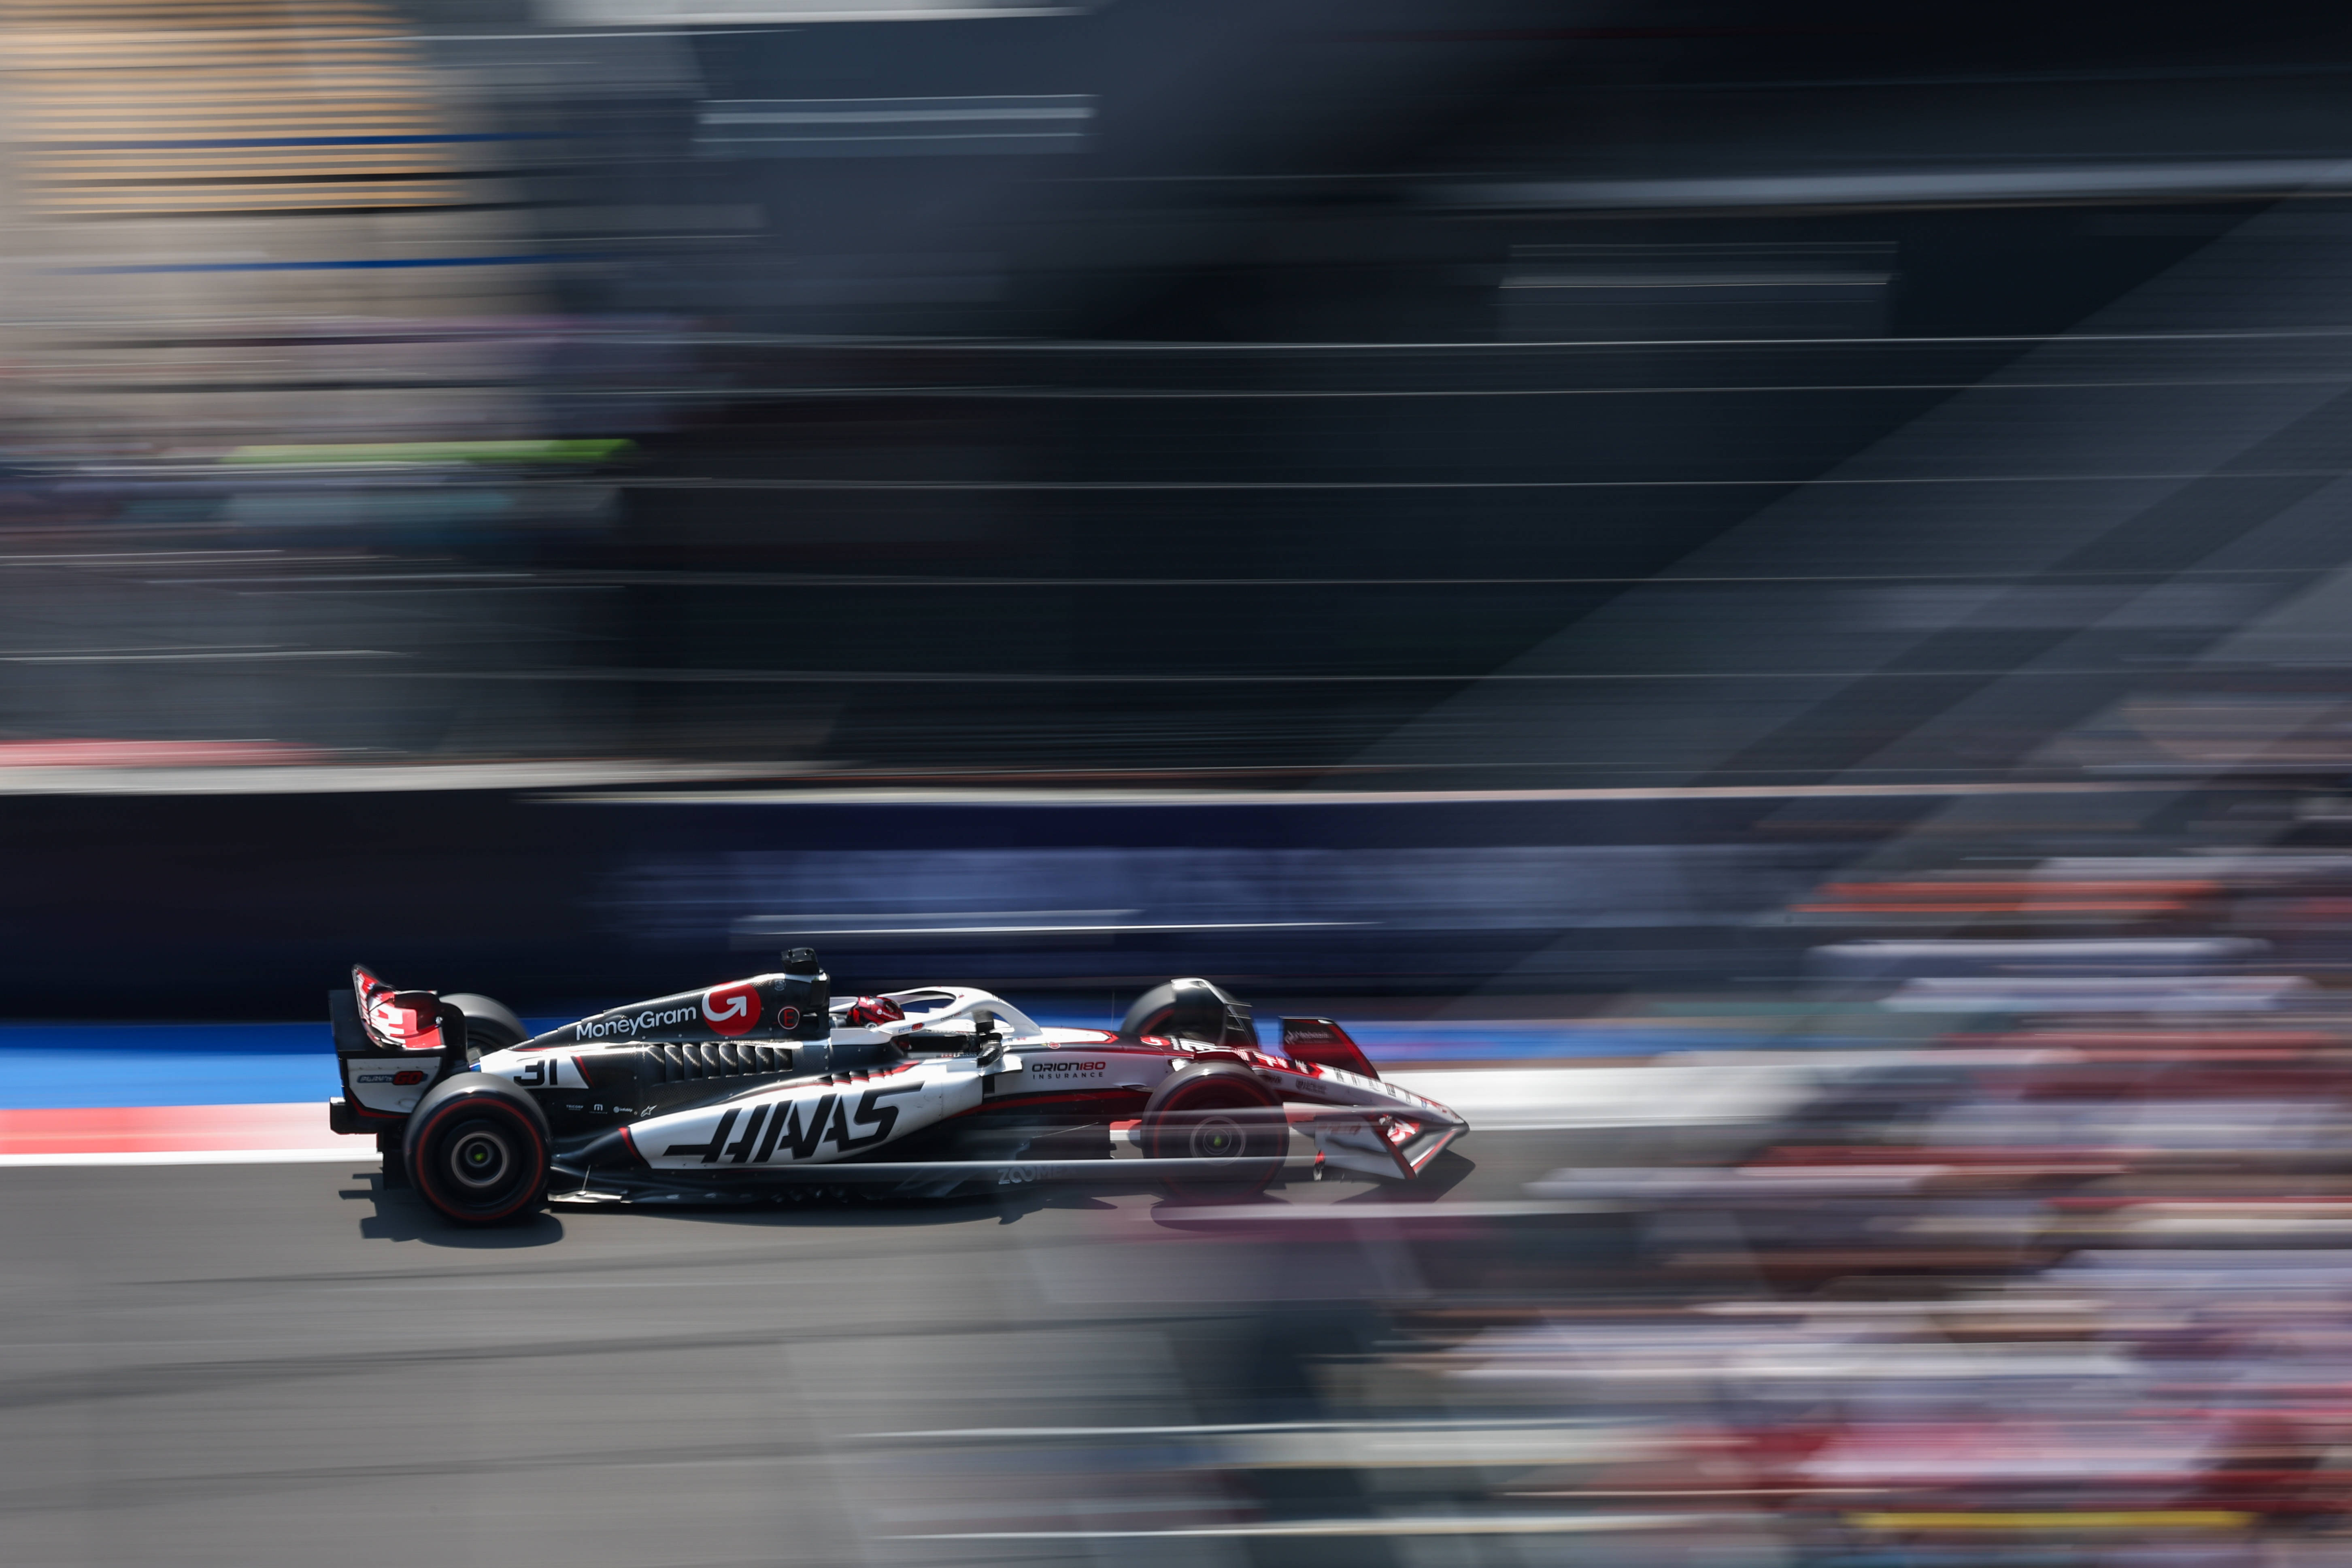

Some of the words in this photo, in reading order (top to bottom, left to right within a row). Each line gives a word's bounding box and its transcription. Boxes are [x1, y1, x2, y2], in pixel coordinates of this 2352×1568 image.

[576, 1006, 696, 1040] MoneyGram
[784, 1009, 795, 1026] E
[394, 1071, 423, 1085] GO
[514, 1058, 558, 1086] 31
[1032, 1062, 1106, 1072] ORION180
[662, 1080, 926, 1164] HAAS
